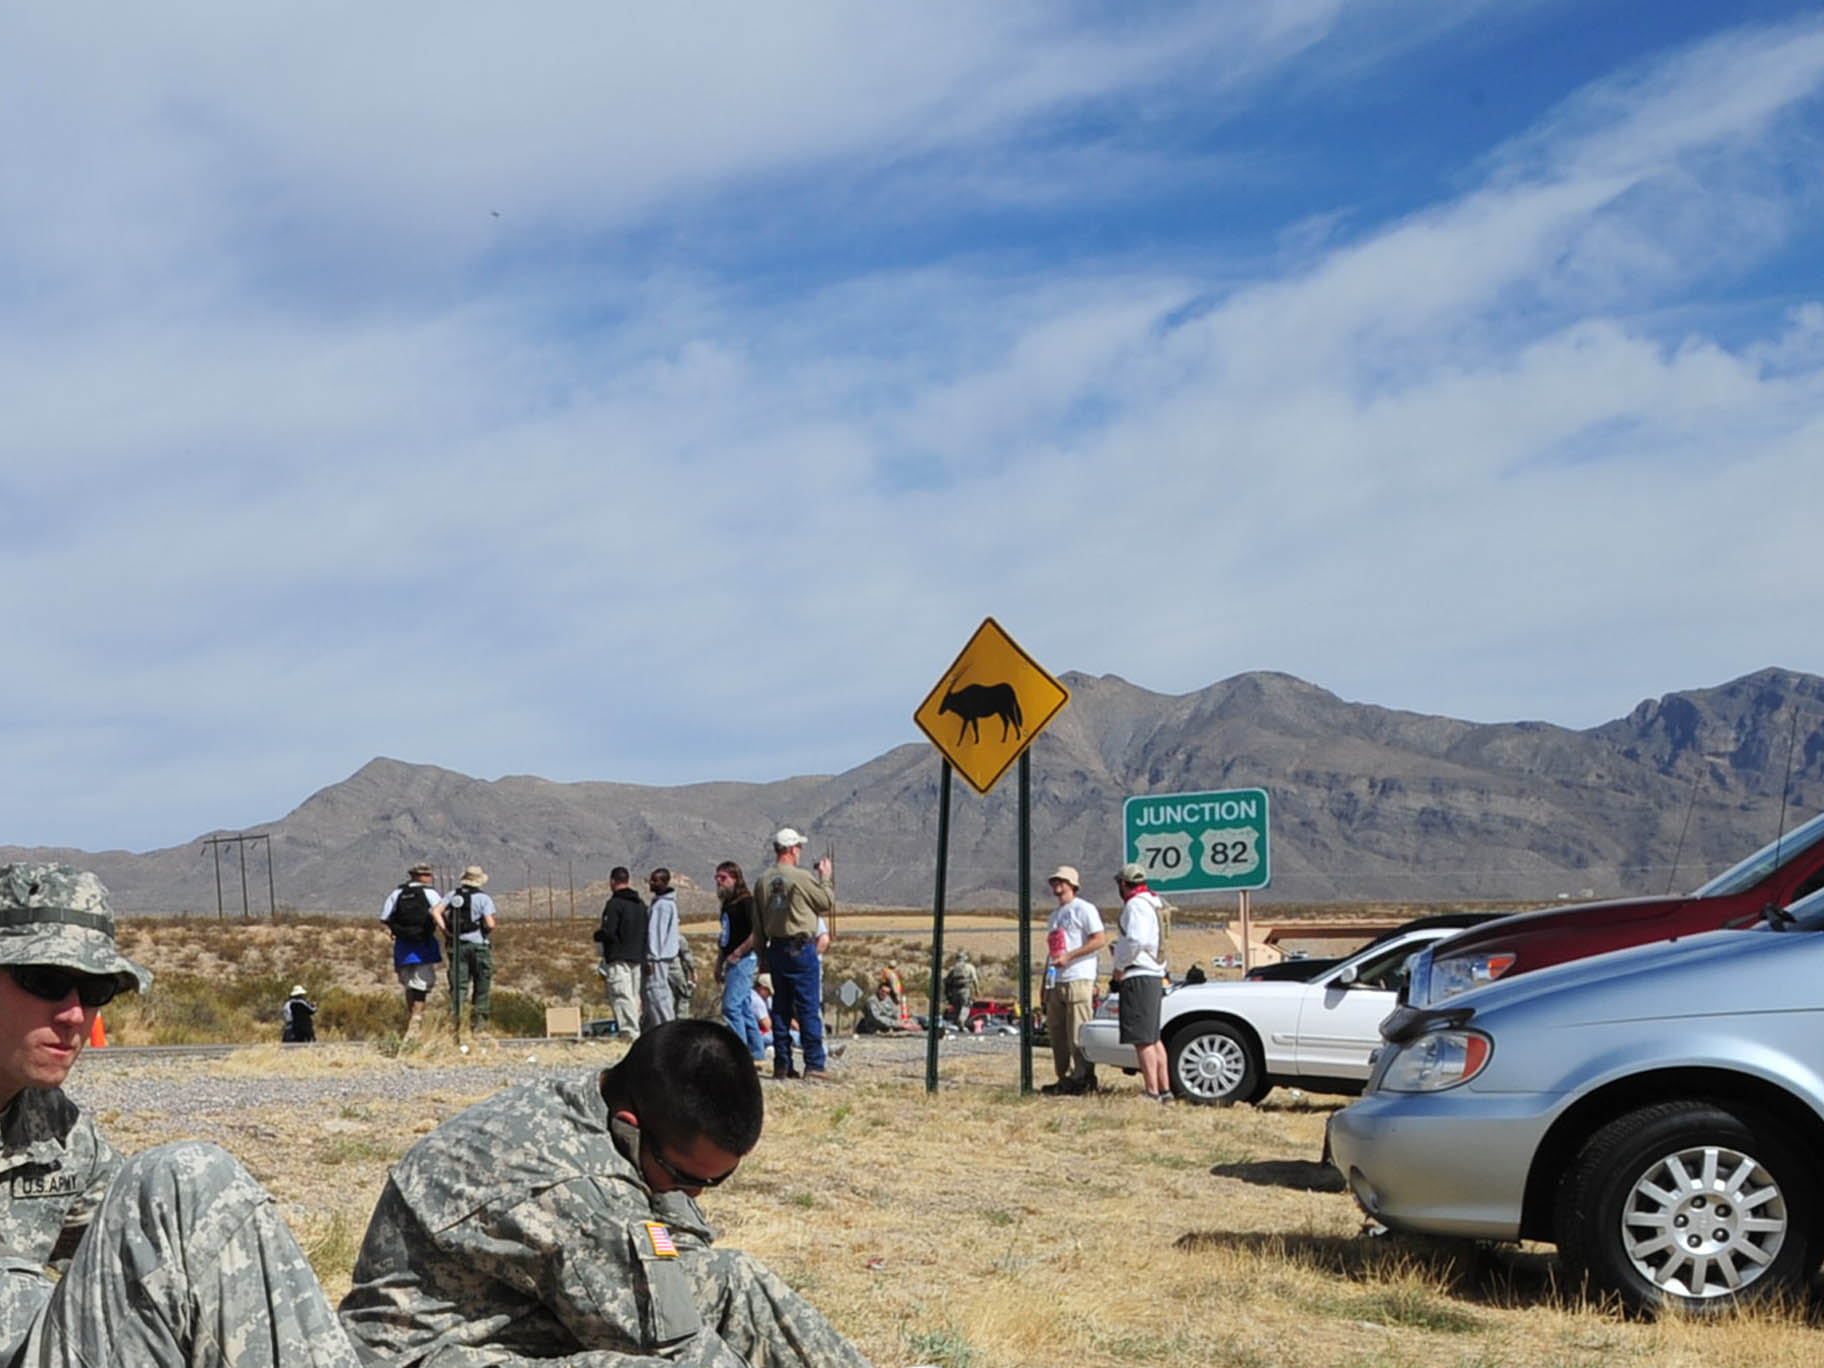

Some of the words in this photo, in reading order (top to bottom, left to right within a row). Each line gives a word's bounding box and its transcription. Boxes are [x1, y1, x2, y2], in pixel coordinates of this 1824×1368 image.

[1135, 800, 1257, 827] JUNCTION
[1146, 846, 1181, 870] 70
[1210, 841, 1248, 865] 82
